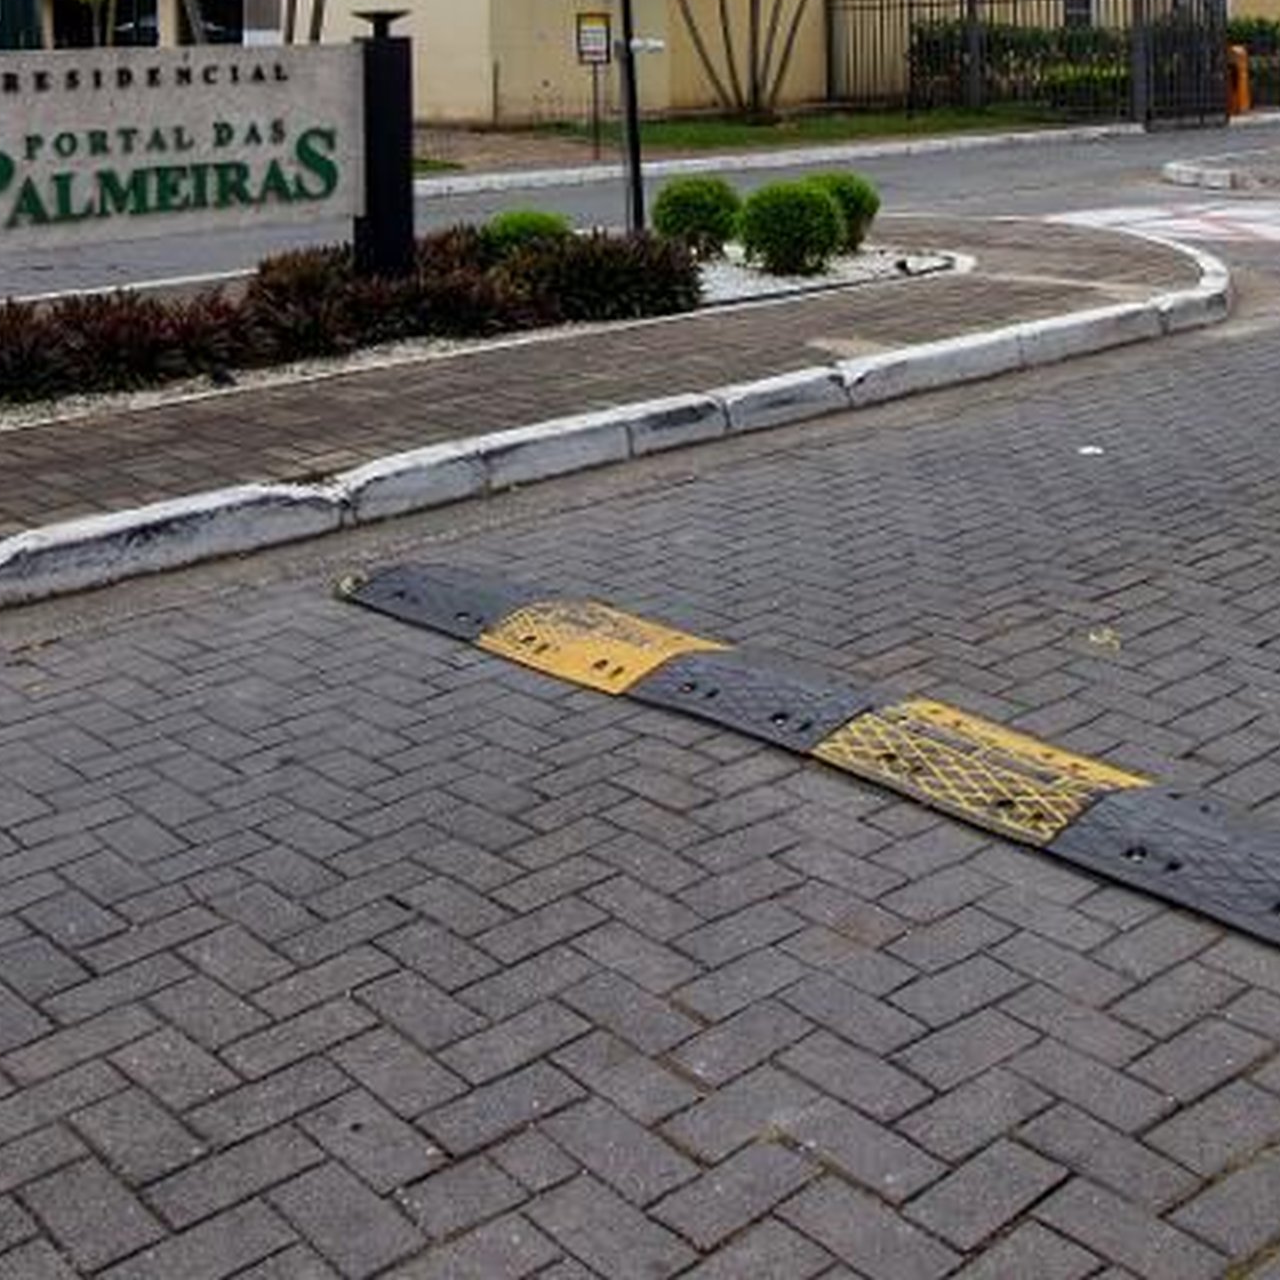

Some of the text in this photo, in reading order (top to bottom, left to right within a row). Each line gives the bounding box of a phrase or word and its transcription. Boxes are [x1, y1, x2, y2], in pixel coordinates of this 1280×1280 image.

[2, 64, 289, 93] RESIDENCIAL
[24, 119, 287, 160] PORTAL DAS
